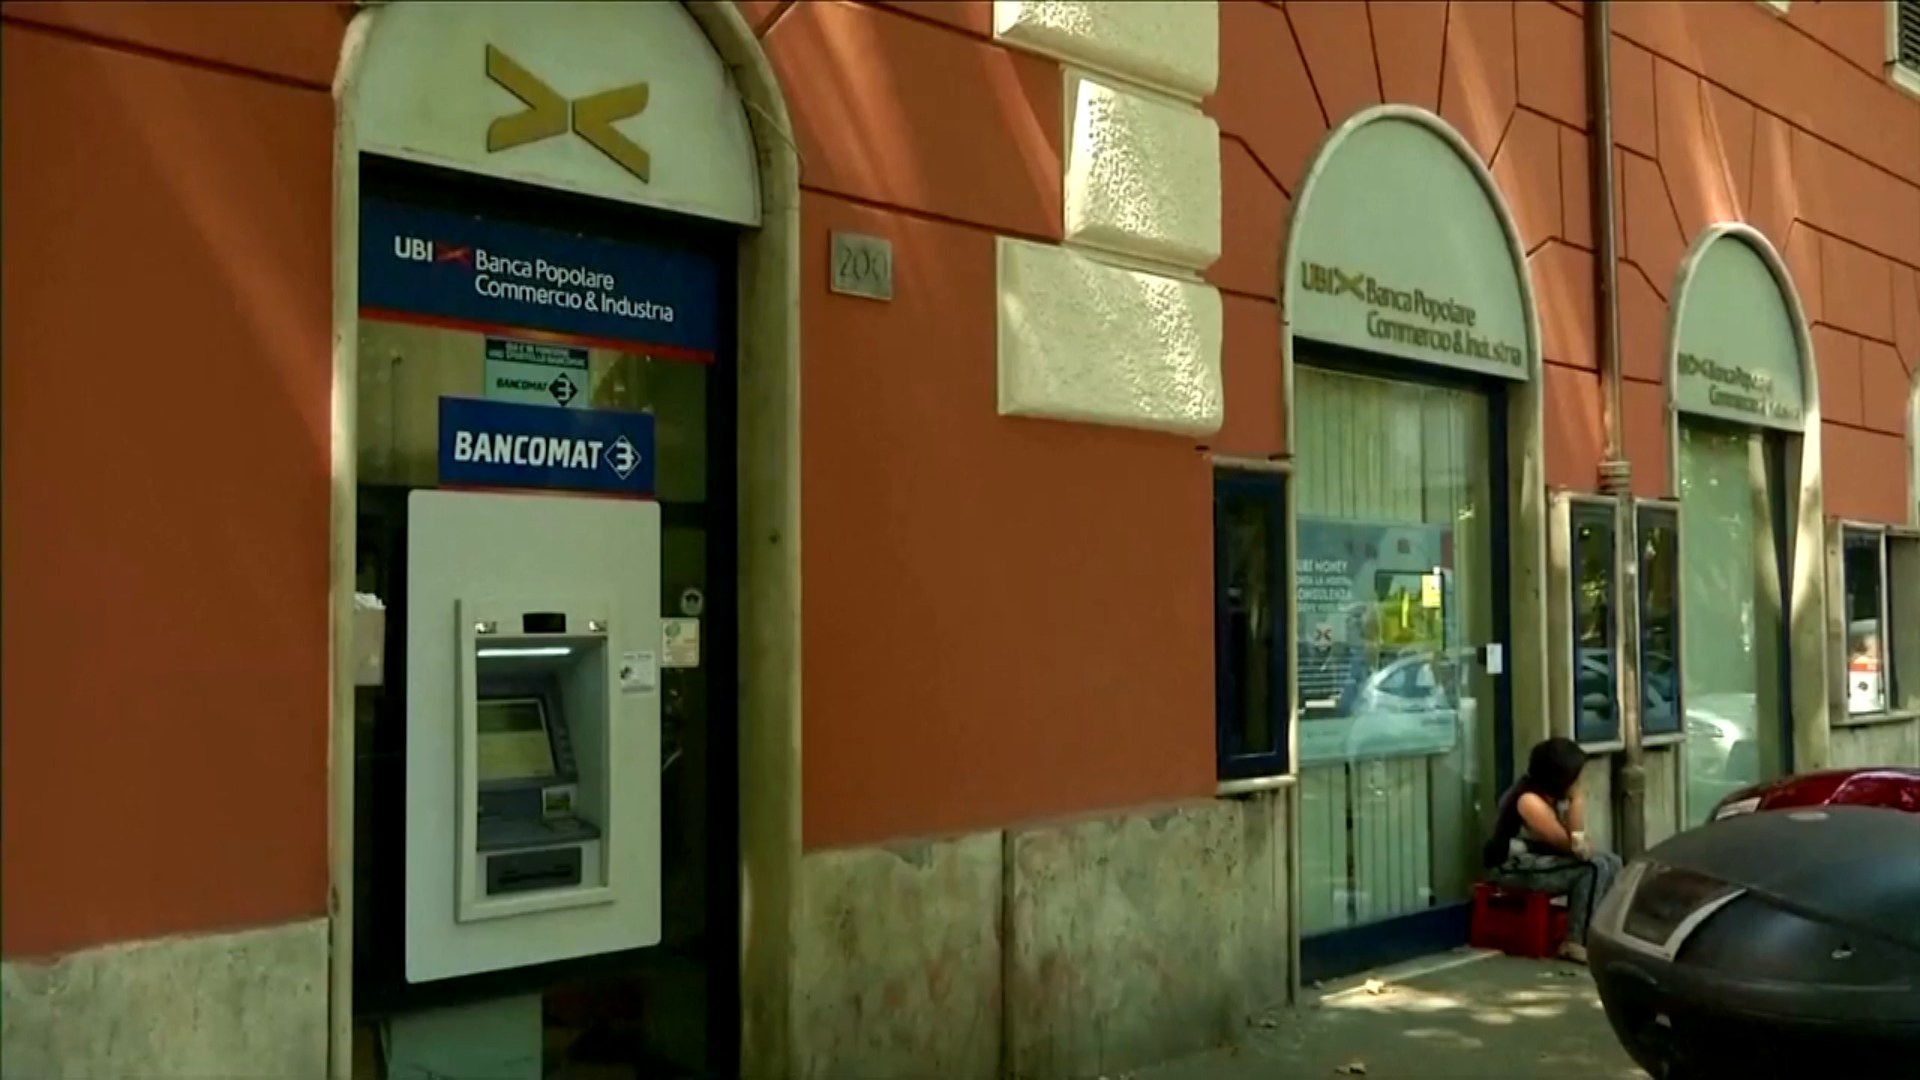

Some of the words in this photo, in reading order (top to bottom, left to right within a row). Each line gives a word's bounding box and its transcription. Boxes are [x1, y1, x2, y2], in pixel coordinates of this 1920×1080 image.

[394, 235, 433, 262] UBI
[475, 249, 532, 278] Banca
[536, 259, 614, 290] Popolare
[839, 245, 888, 281] 200
[475, 274, 582, 309] Commercio
[585, 290, 599, 312] &
[602, 293, 674, 322] Industria
[1301, 261, 1333, 295] UBI
[1365, 276, 1412, 312] Banca
[1414, 289, 1476, 327] Popolare
[1454, 329, 1465, 355] &
[454, 430, 603, 470] BANCOMAT
